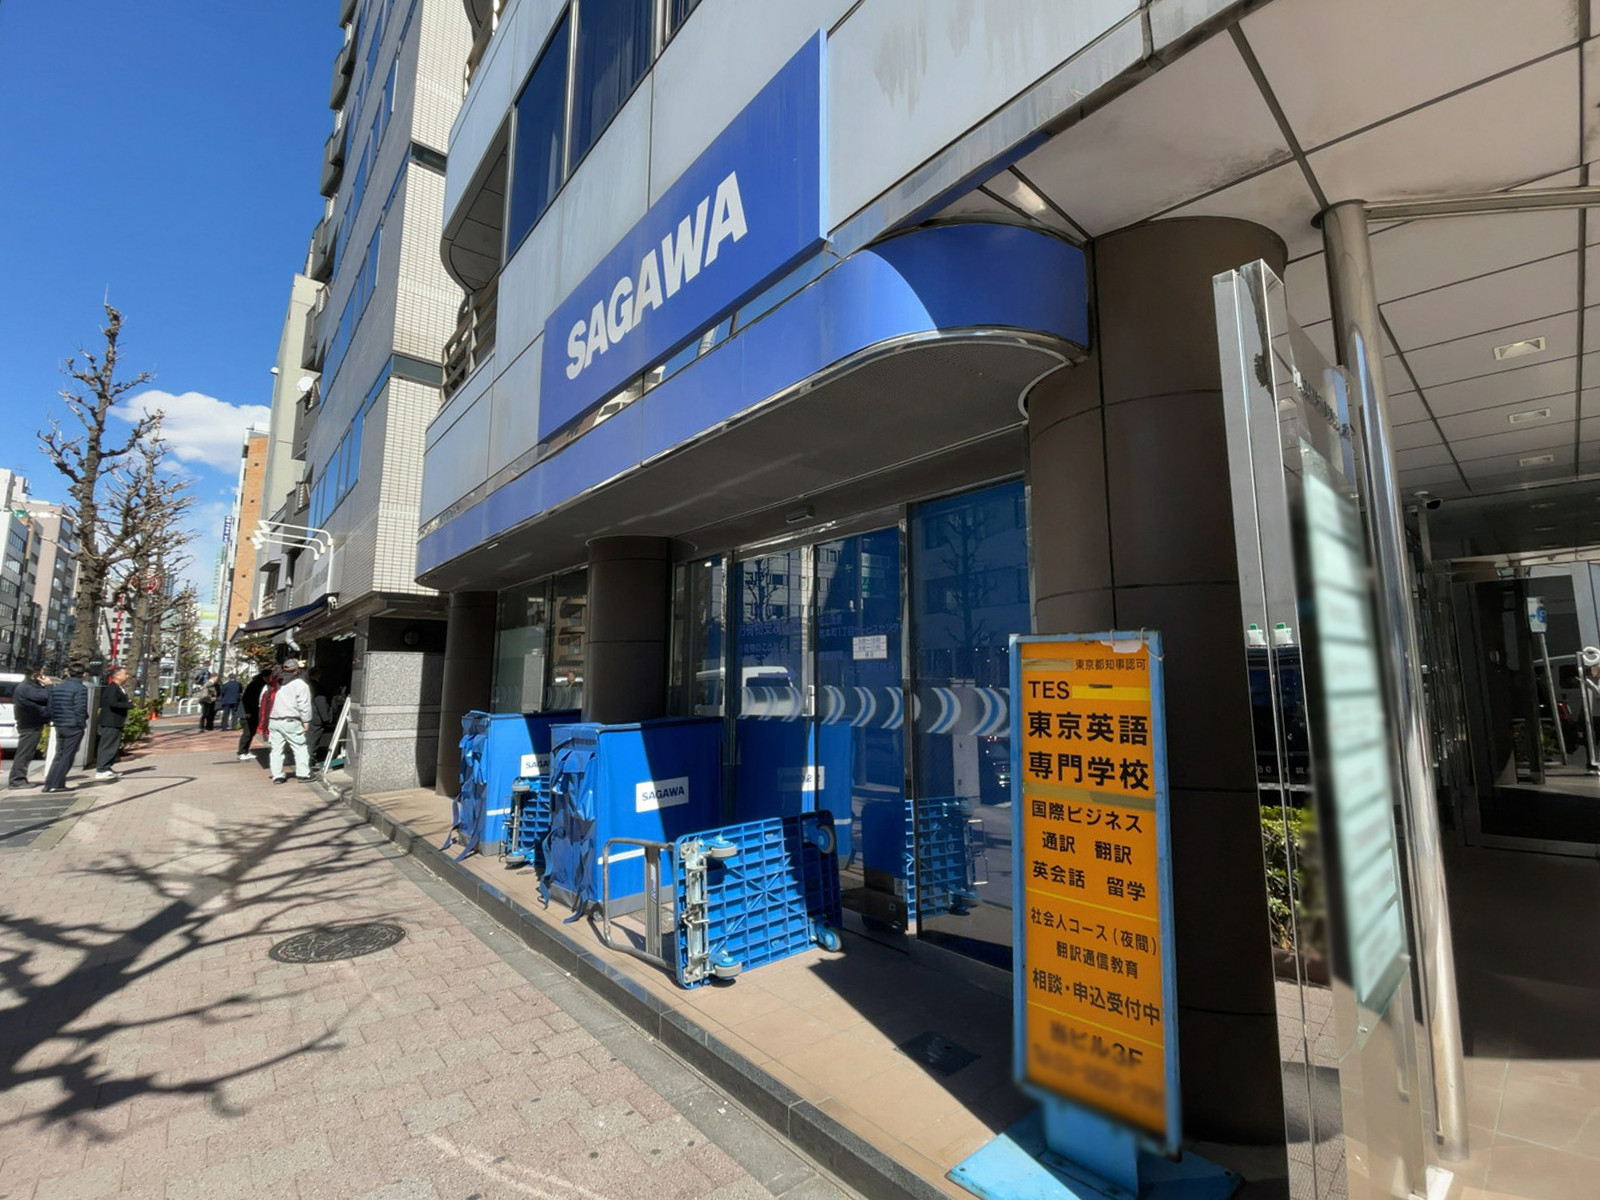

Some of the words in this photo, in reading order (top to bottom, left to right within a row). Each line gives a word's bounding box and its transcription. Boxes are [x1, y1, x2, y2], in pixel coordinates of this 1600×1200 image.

[566, 171, 748, 380] SAGAWA
[1075, 659, 1146, 671] 東京都知事認可
[1028, 681, 1070, 699] TES
[1028, 711, 1148, 746] 東京英語
[525, 760, 549, 769] SAGA
[1028, 751, 1150, 791] 専門学校
[642, 786, 685, 802] SAGAWA
[1032, 800, 1143, 833] 国際ビジネス
[1041, 831, 1075, 854] 通訳
[1094, 841, 1132, 865] 翻訳
[1033, 860, 1085, 888] 英会話
[1106, 876, 1146, 901] 留学
[1056, 941, 1138, 979] 翻訳通信教育
[1032, 968, 1160, 1025] 相談・申込受付中
